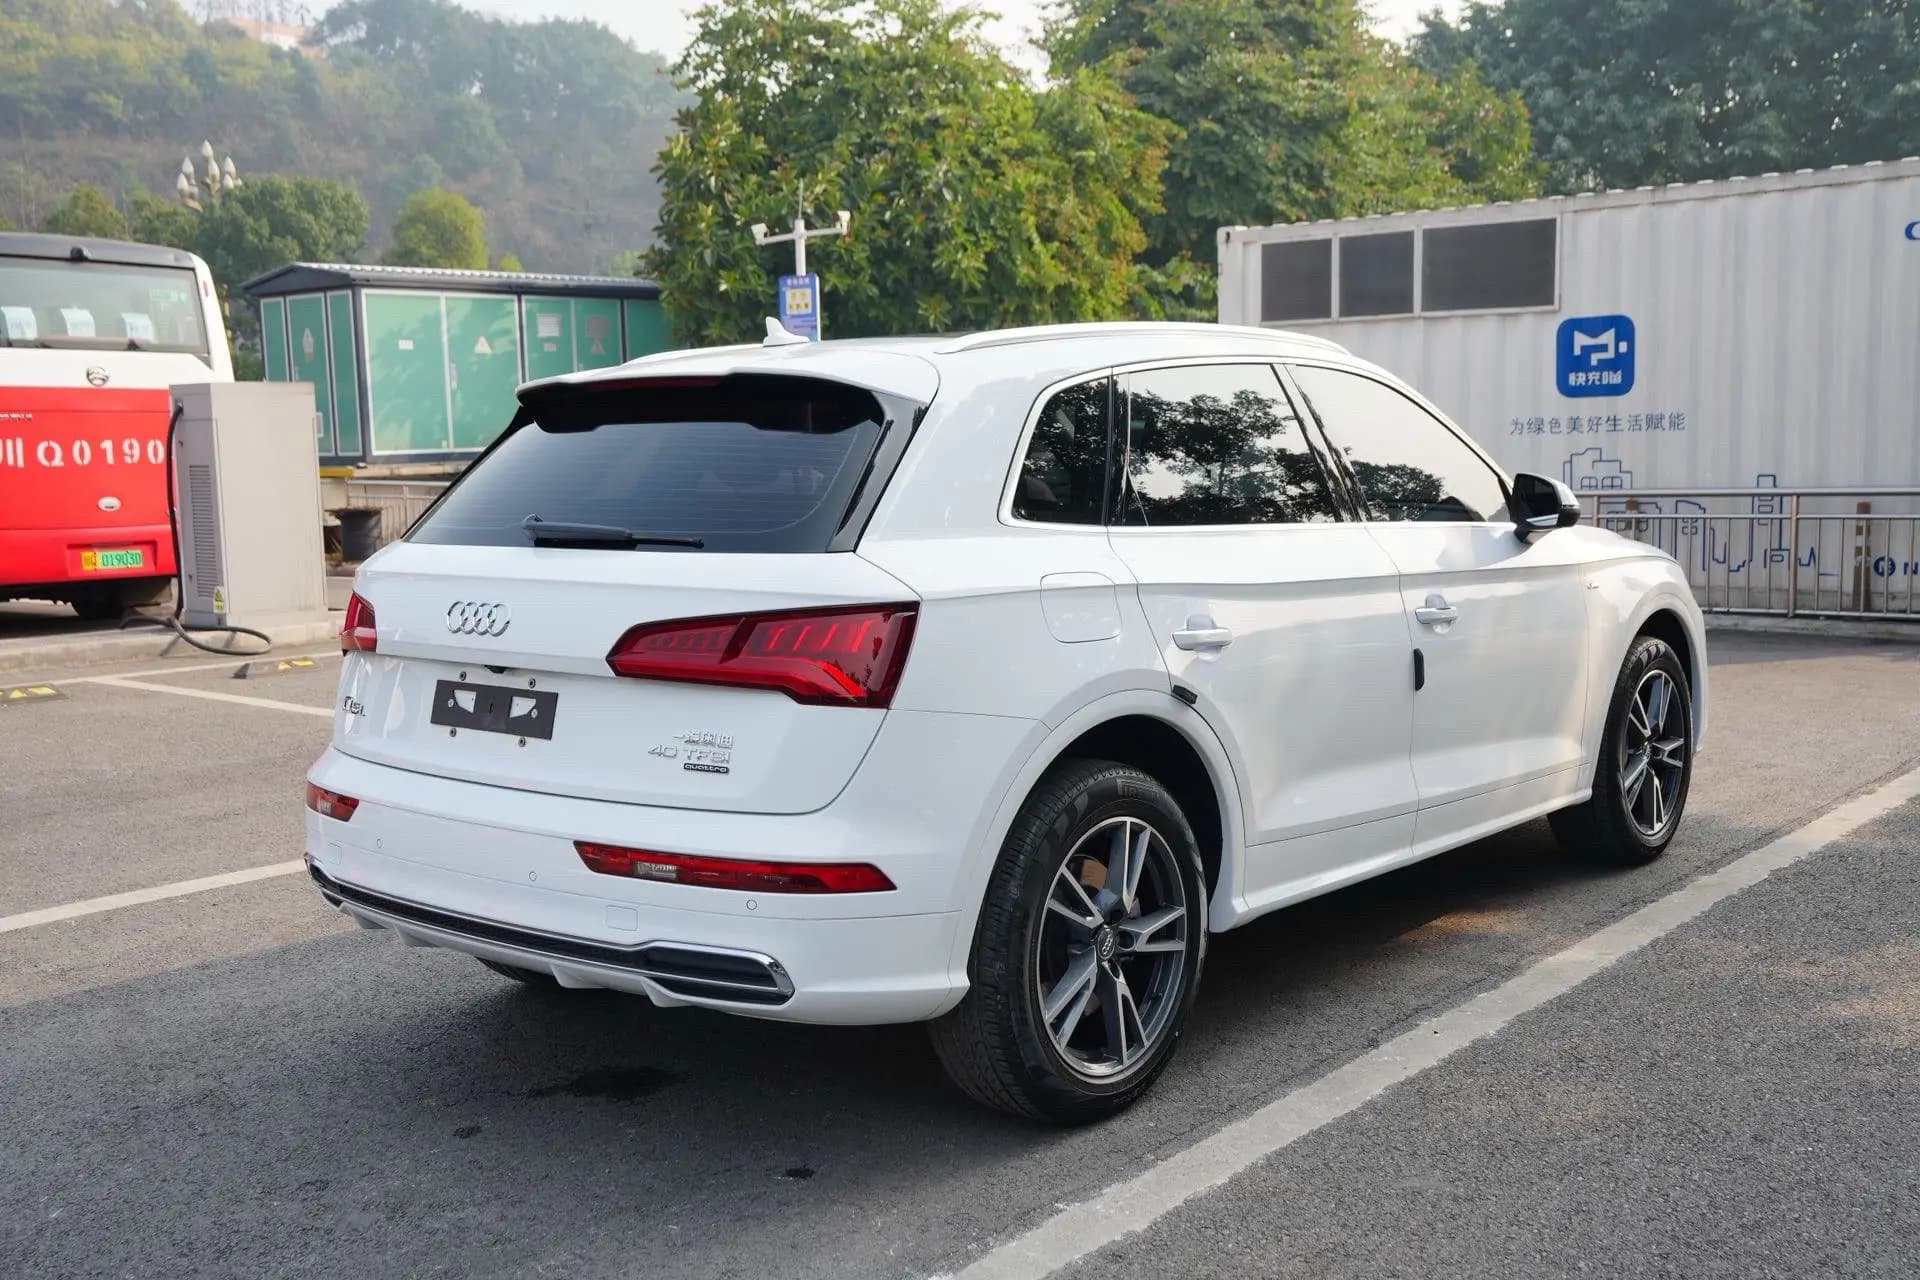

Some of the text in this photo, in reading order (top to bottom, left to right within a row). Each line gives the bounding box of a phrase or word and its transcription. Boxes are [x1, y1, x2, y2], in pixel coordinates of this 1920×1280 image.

[1510, 412, 1686, 436] 为绿色美好生活赋能
[647, 744, 731, 763] 40 TFSI
[684, 763, 728, 773] quattro
